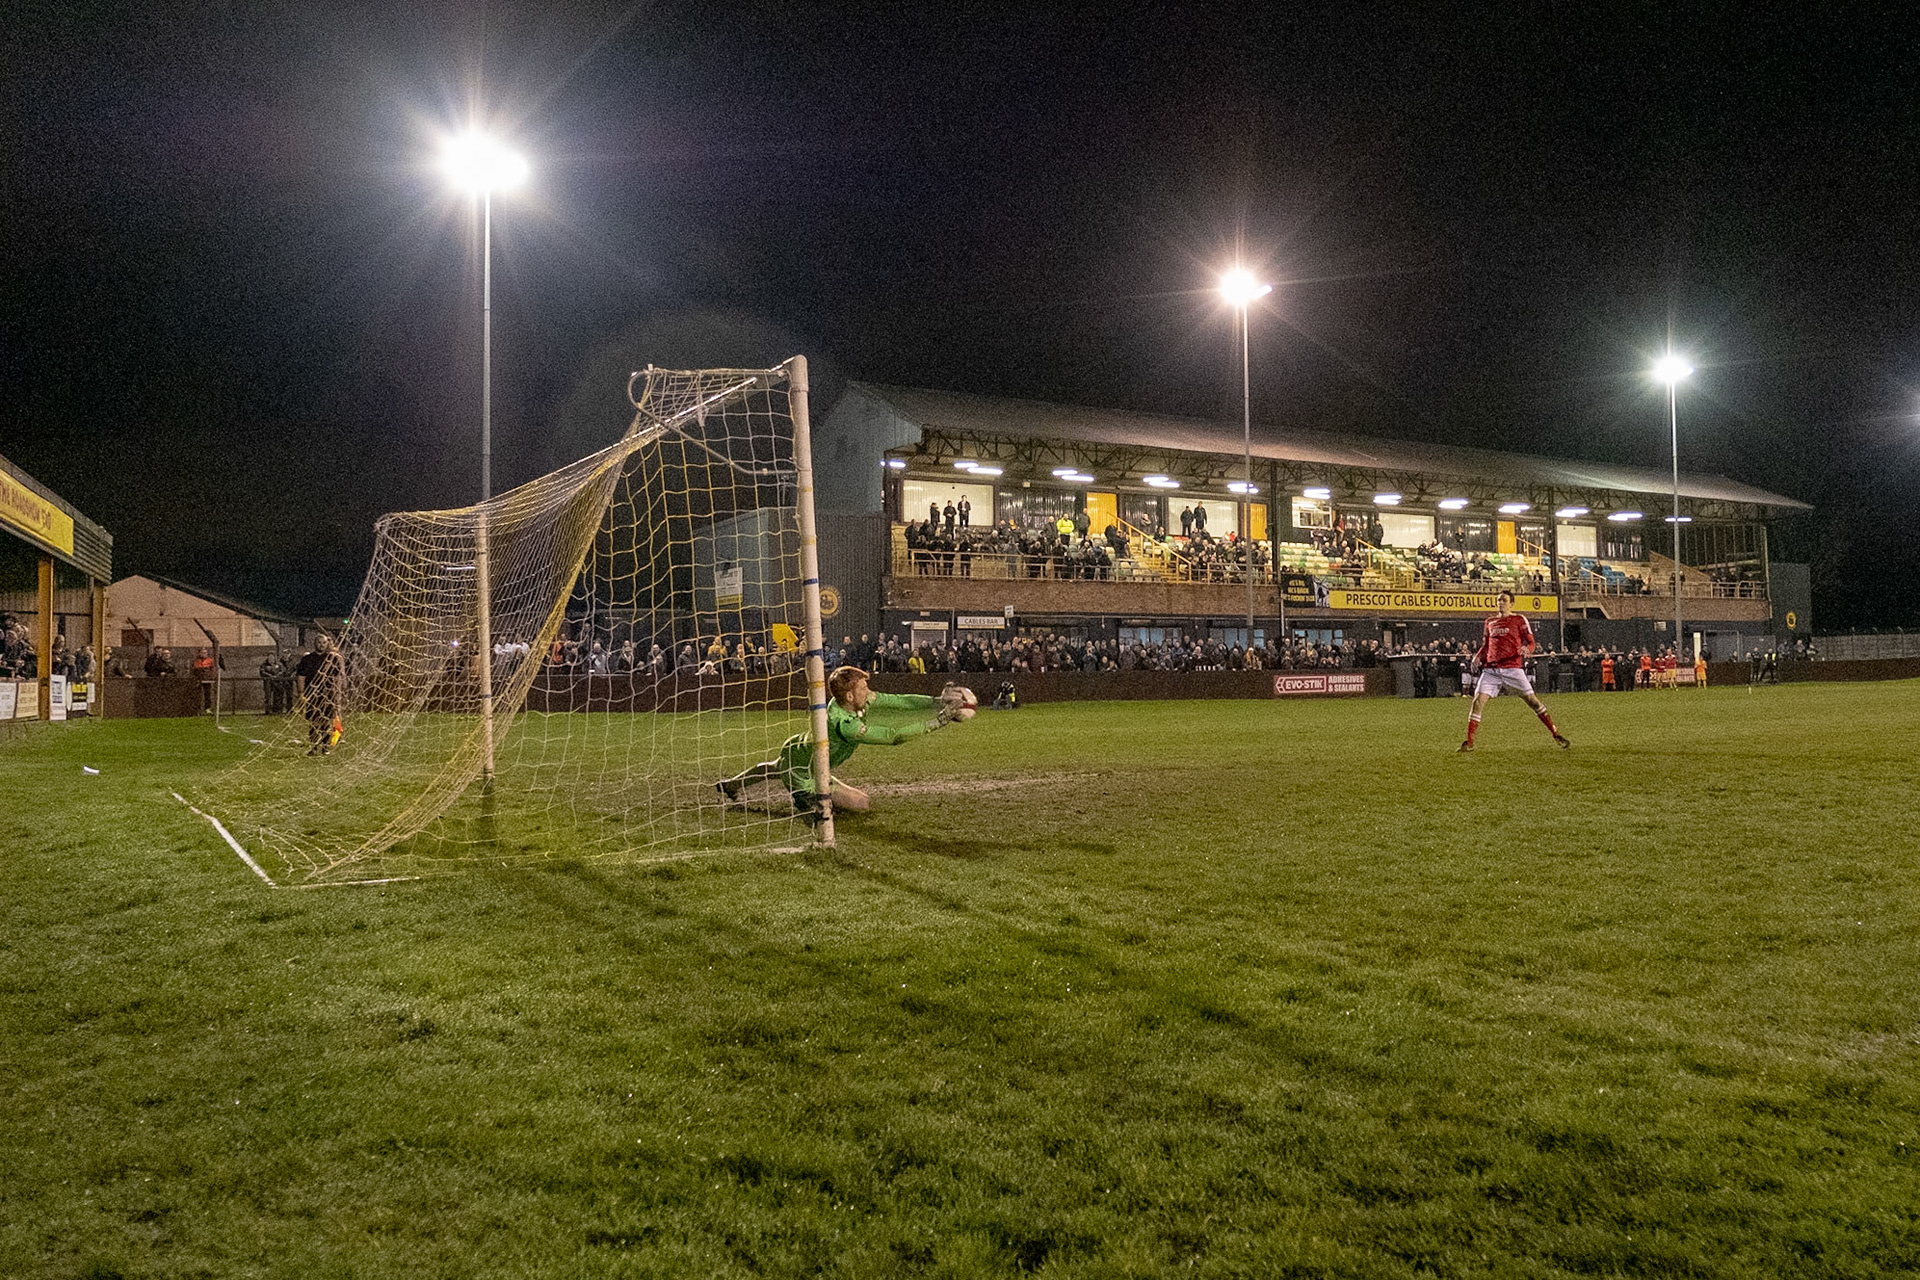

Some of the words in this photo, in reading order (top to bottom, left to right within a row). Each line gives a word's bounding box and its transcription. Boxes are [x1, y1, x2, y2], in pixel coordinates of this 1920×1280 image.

[1346, 593, 1392, 607] PRESCOT
[1394, 594, 1431, 607] CABLES
[1433, 595, 1482, 608] FOOTBALL
[1285, 679, 1323, 690] EVO-STIK
[1328, 675, 1365, 684] ADHESIVES
[1328, 684, 1333, 692] &
[1334, 683, 1364, 692] SEALANTS
